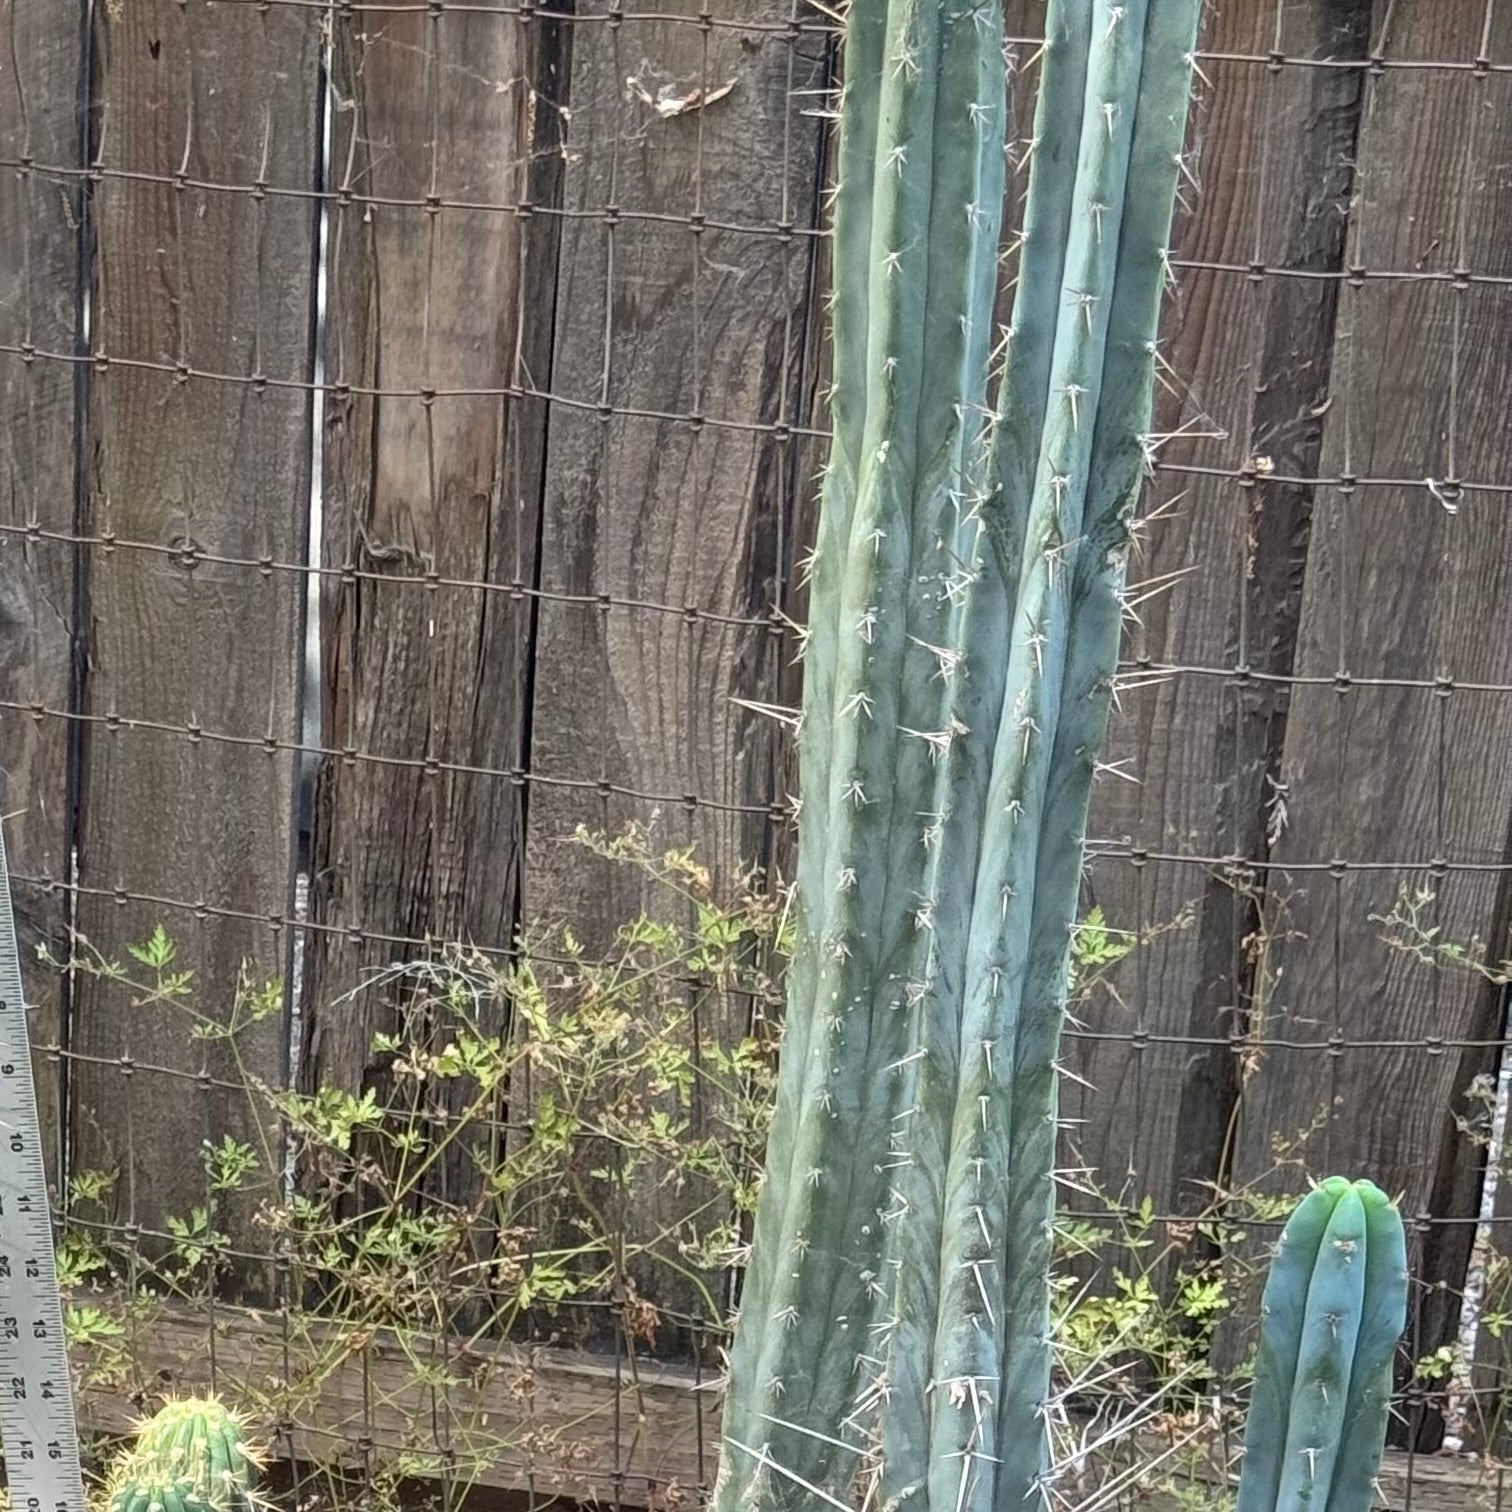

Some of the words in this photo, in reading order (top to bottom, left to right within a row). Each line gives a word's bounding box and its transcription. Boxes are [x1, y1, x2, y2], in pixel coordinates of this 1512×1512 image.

[2, 1064, 15, 1075] 9
[10, 1132, 24, 1152] 10
[17, 1195, 31, 1213] 11
[25, 1258, 39, 1278] 12
[5, 1317, 19, 1339] 23
[33, 1319, 47, 1338] 13
[12, 1377, 26, 1400] 22
[40, 1380, 55, 1399] 14
[20, 1441, 33, 1460] 21
[48, 1440, 61, 1459] 15
